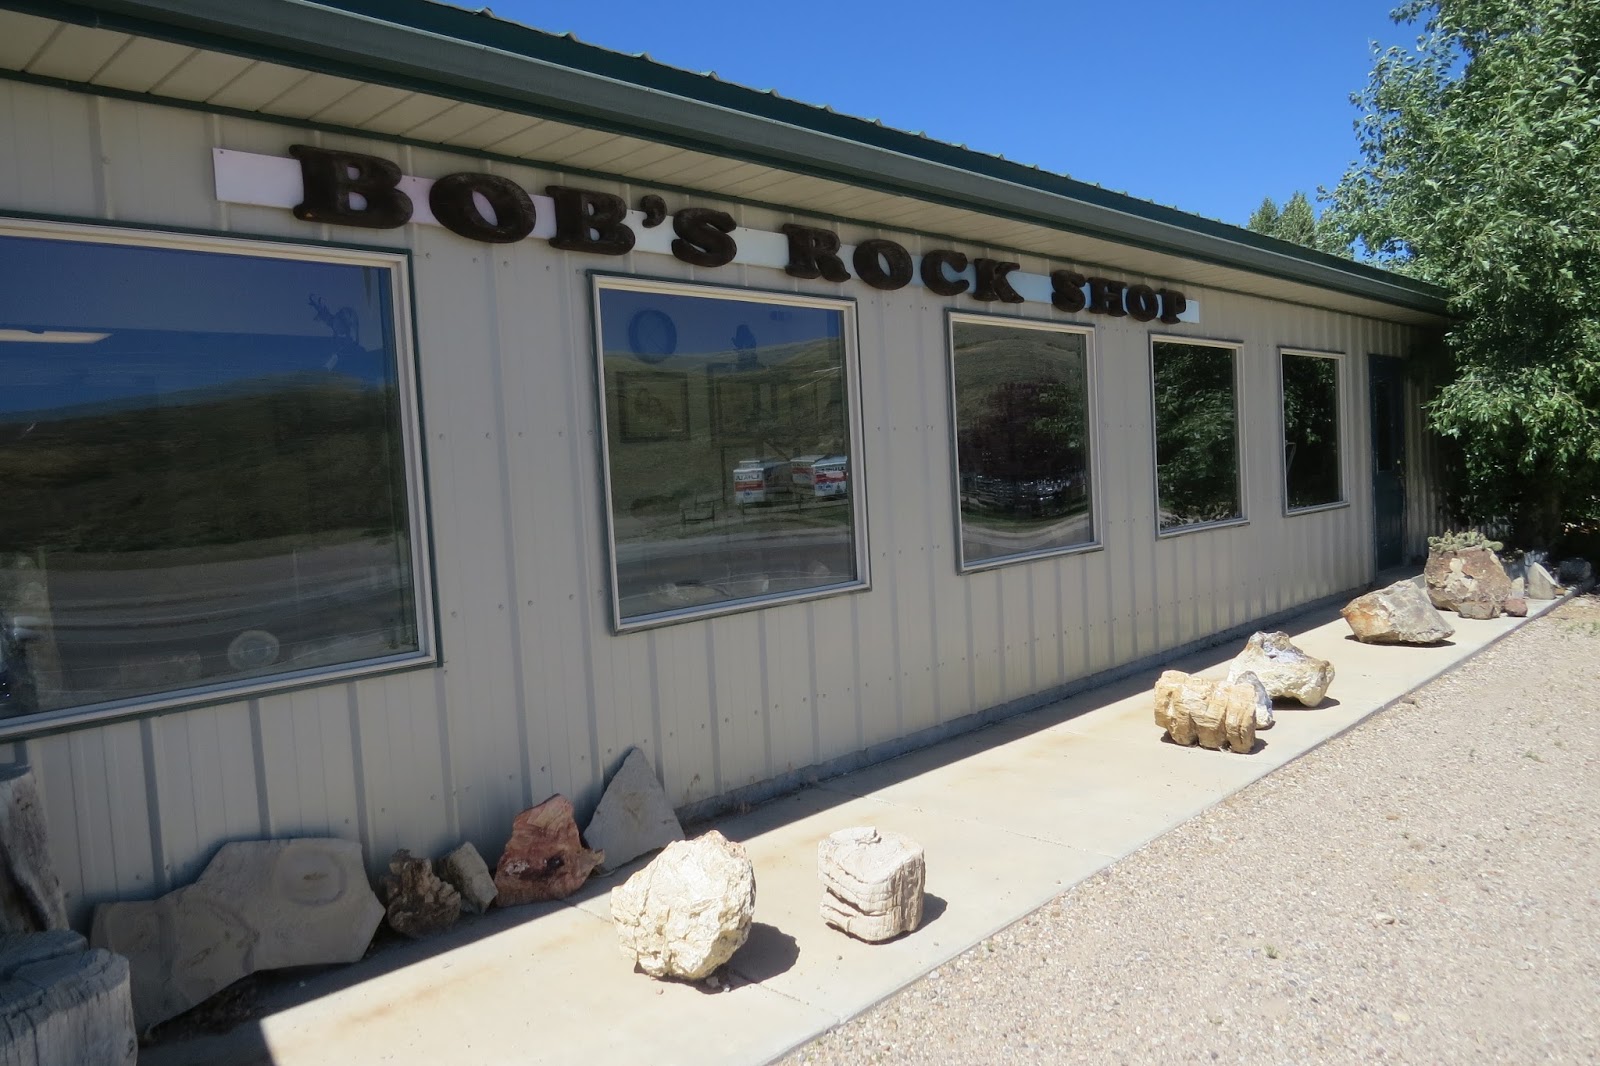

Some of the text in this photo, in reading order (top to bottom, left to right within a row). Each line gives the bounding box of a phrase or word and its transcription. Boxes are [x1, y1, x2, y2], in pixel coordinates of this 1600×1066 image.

[289, 144, 1187, 324] BOB'S ROCK SHOP
